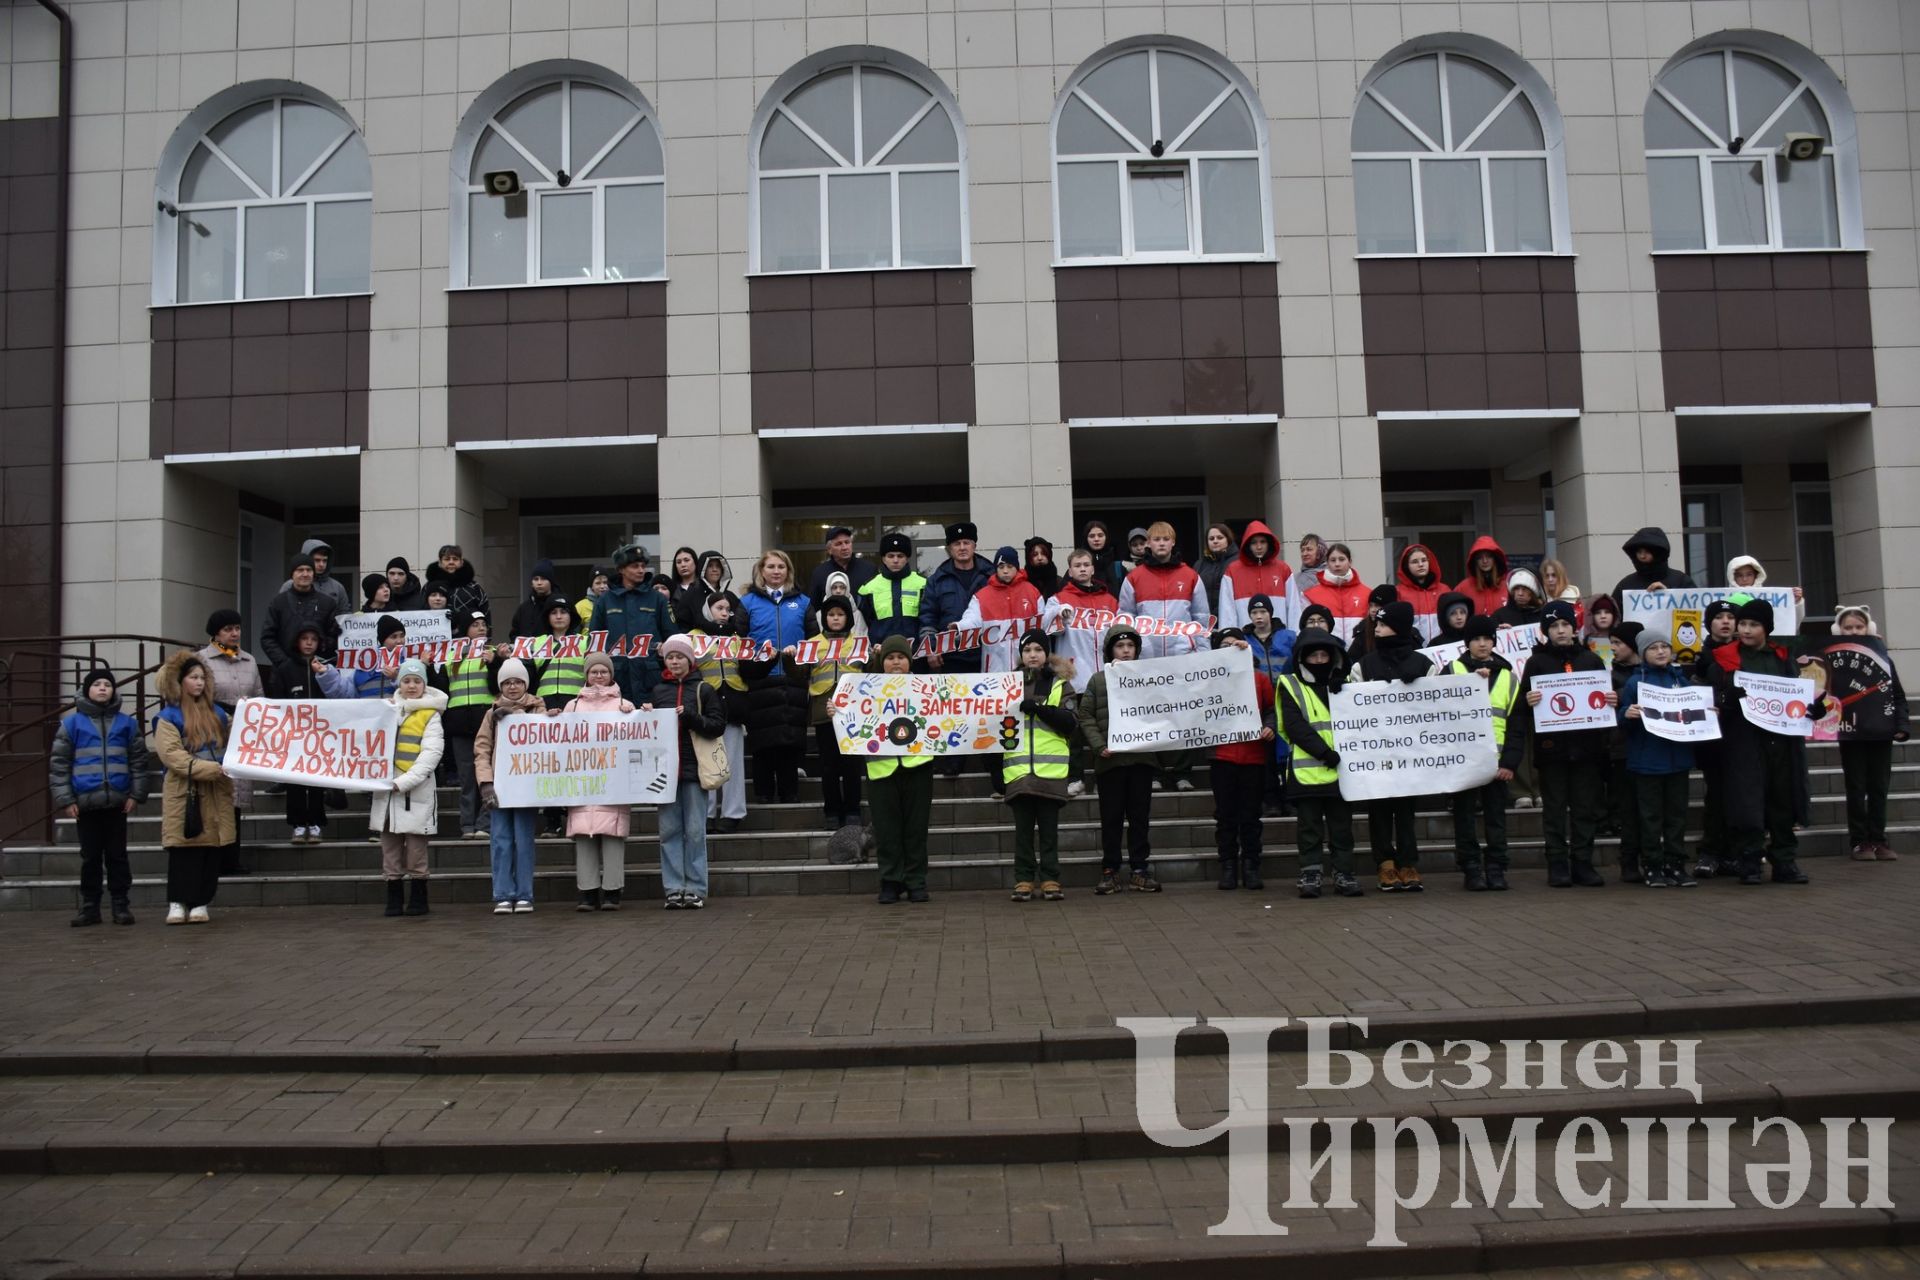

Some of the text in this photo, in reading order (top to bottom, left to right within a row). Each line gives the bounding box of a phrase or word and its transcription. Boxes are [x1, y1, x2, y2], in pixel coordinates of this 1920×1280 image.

[400, 617, 440, 629] аждая
[336, 607, 1217, 671] ПОМНИТЕ КАЖДАЯ УКВА ПДД АПИСАНА КРОВЬЮ!
[343, 636, 373, 649] буква
[1833, 658, 1844, 668] 60
[1119, 666, 1230, 689] Каждое слово,
[1120, 694, 1223, 718] написанное за
[1353, 686, 1480, 707] Световозвраща-
[1642, 692, 1702, 704] ПРИСТЕГНИСЬ
[861, 699, 916, 716] СТАНЬ
[1204, 703, 1253, 722] рулём,
[508, 720, 659, 746] СОБЛЮДАЙ ПРАВИЛА!
[1333, 717, 1378, 732] ющие
[366, 729, 386, 757] И
[1112, 727, 1206, 744] может стать
[1339, 730, 1486, 752] не только безопа-
[238, 745, 389, 779] ТЕБЯ ДОЖДУТСЯ
[509, 746, 618, 775] ЖИЗНЬ ДОРОЖЕ
[1398, 758, 1407, 769] и
[1413, 754, 1465, 769] модно
